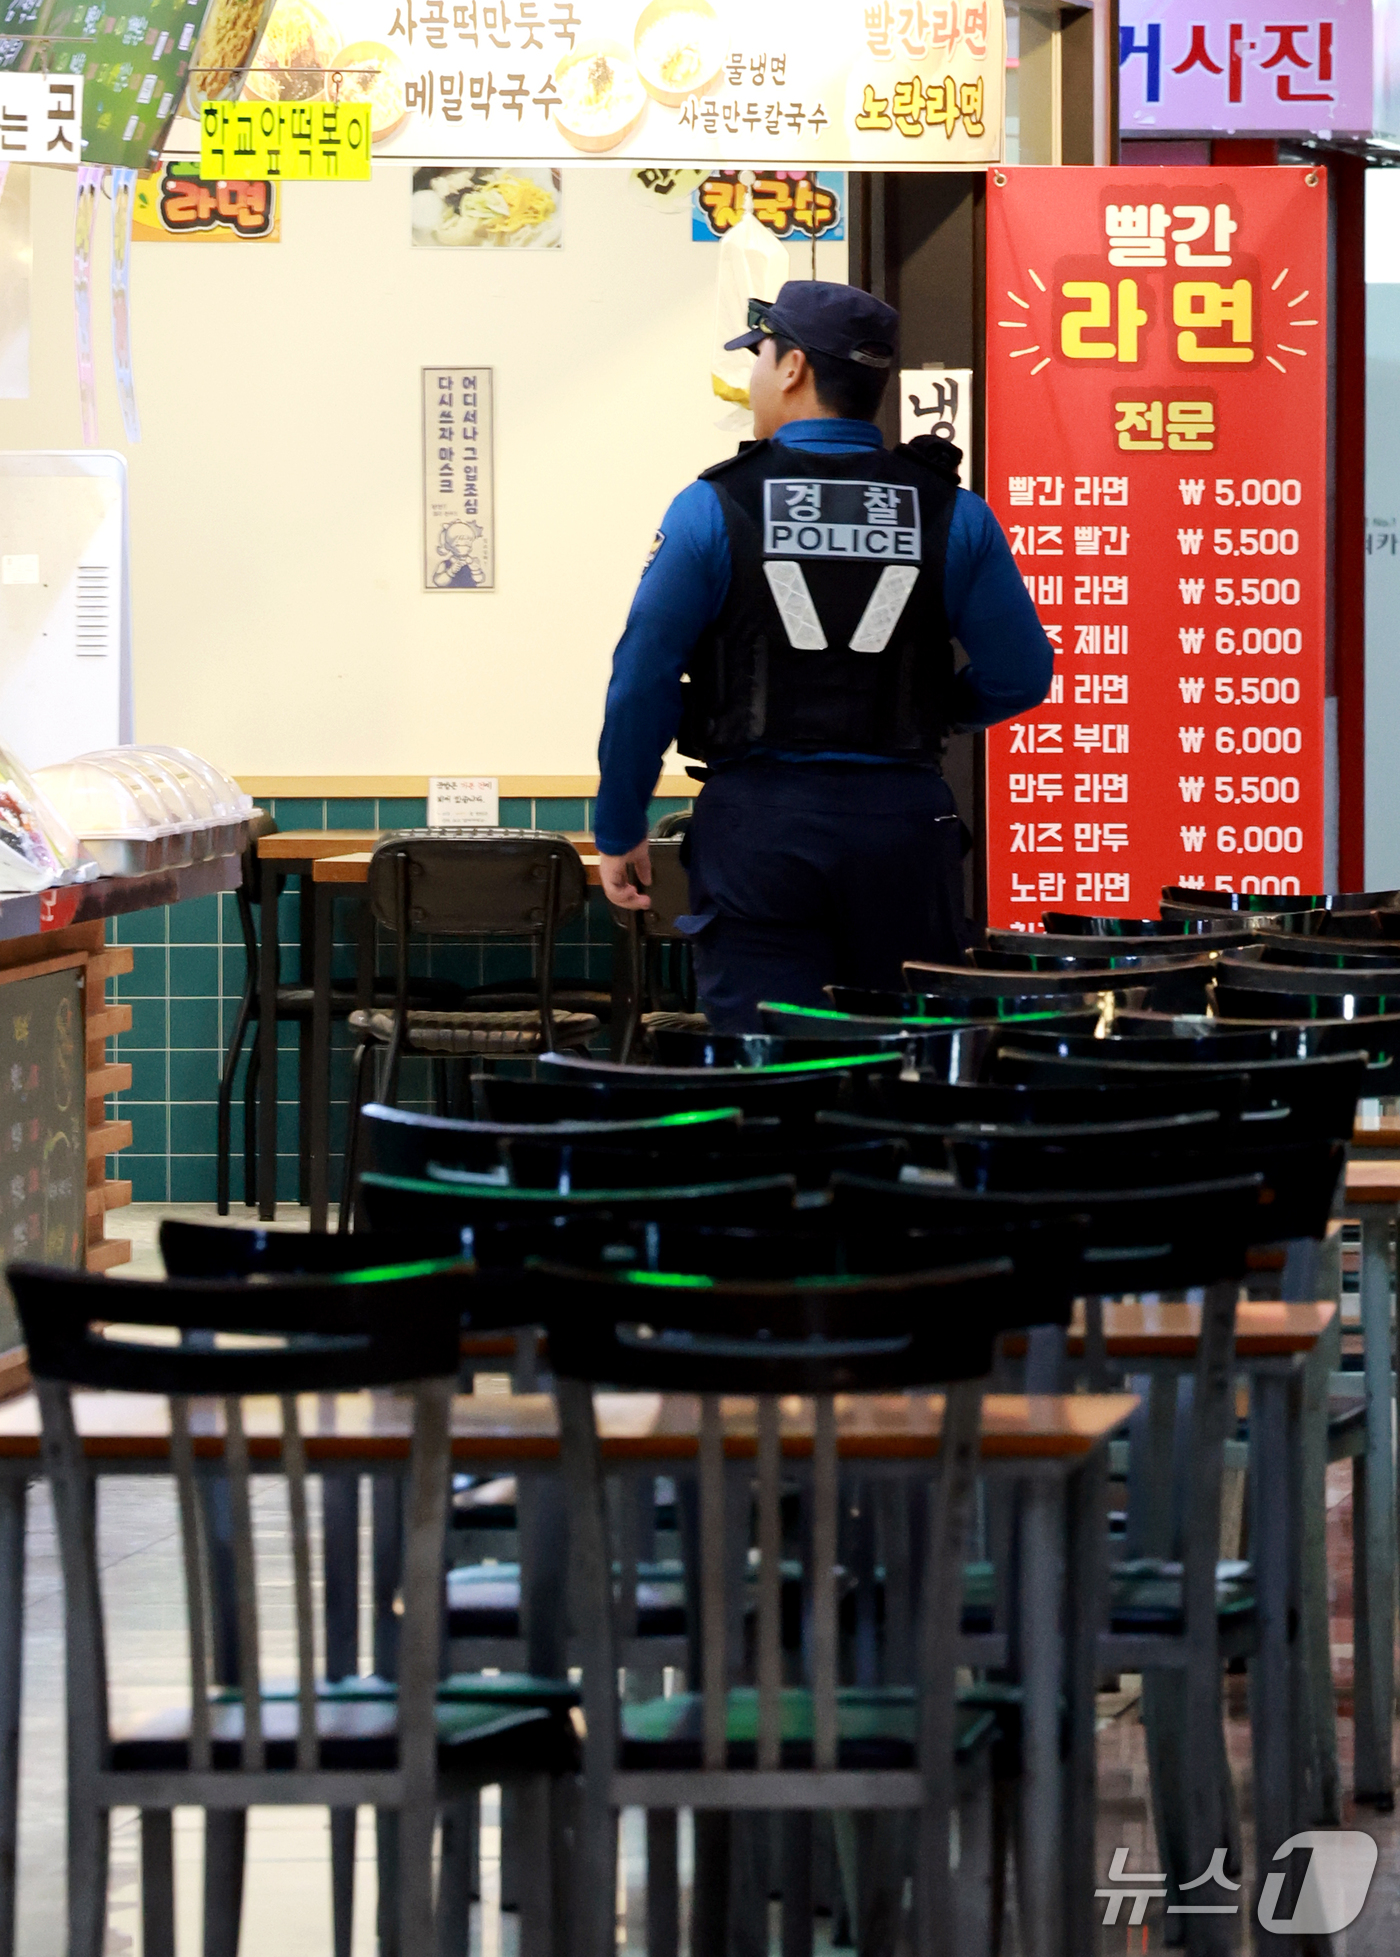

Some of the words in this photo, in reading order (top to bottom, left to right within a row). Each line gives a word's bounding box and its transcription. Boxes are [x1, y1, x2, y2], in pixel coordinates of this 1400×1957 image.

[864, 0, 988, 56] 빨간라면
[726, 53, 786, 86] 물냉면
[405, 70, 563, 122] 메밀막국수
[856, 75, 985, 140] 노란라면
[678, 98, 828, 136] 사골만두칼국수
[203, 103, 370, 176] 학교앞떡볶이
[163, 178, 269, 230] 라면
[1105, 203, 1239, 268] 빨간
[1114, 401, 1217, 452] 전문
[1009, 476, 1065, 507] 빨간
[1074, 477, 1129, 506] 라면
[771, 525, 915, 556] POLICE
[1009, 524, 1064, 557] 치즈
[1074, 526, 1130, 556] 빨간
[1074, 576, 1129, 606] 라면
[1074, 625, 1129, 656] 제비
[1074, 674, 1129, 705] 라면
[1009, 723, 1064, 754] 치즈
[1073, 724, 1130, 754] 부대
[1009, 773, 1064, 804] 만두
[1074, 773, 1129, 804] 라면
[1009, 822, 1064, 854] 치즈
[1074, 823, 1130, 853] 만두
[1010, 872, 1067, 902] 노란
[1076, 873, 1131, 903] 라면
